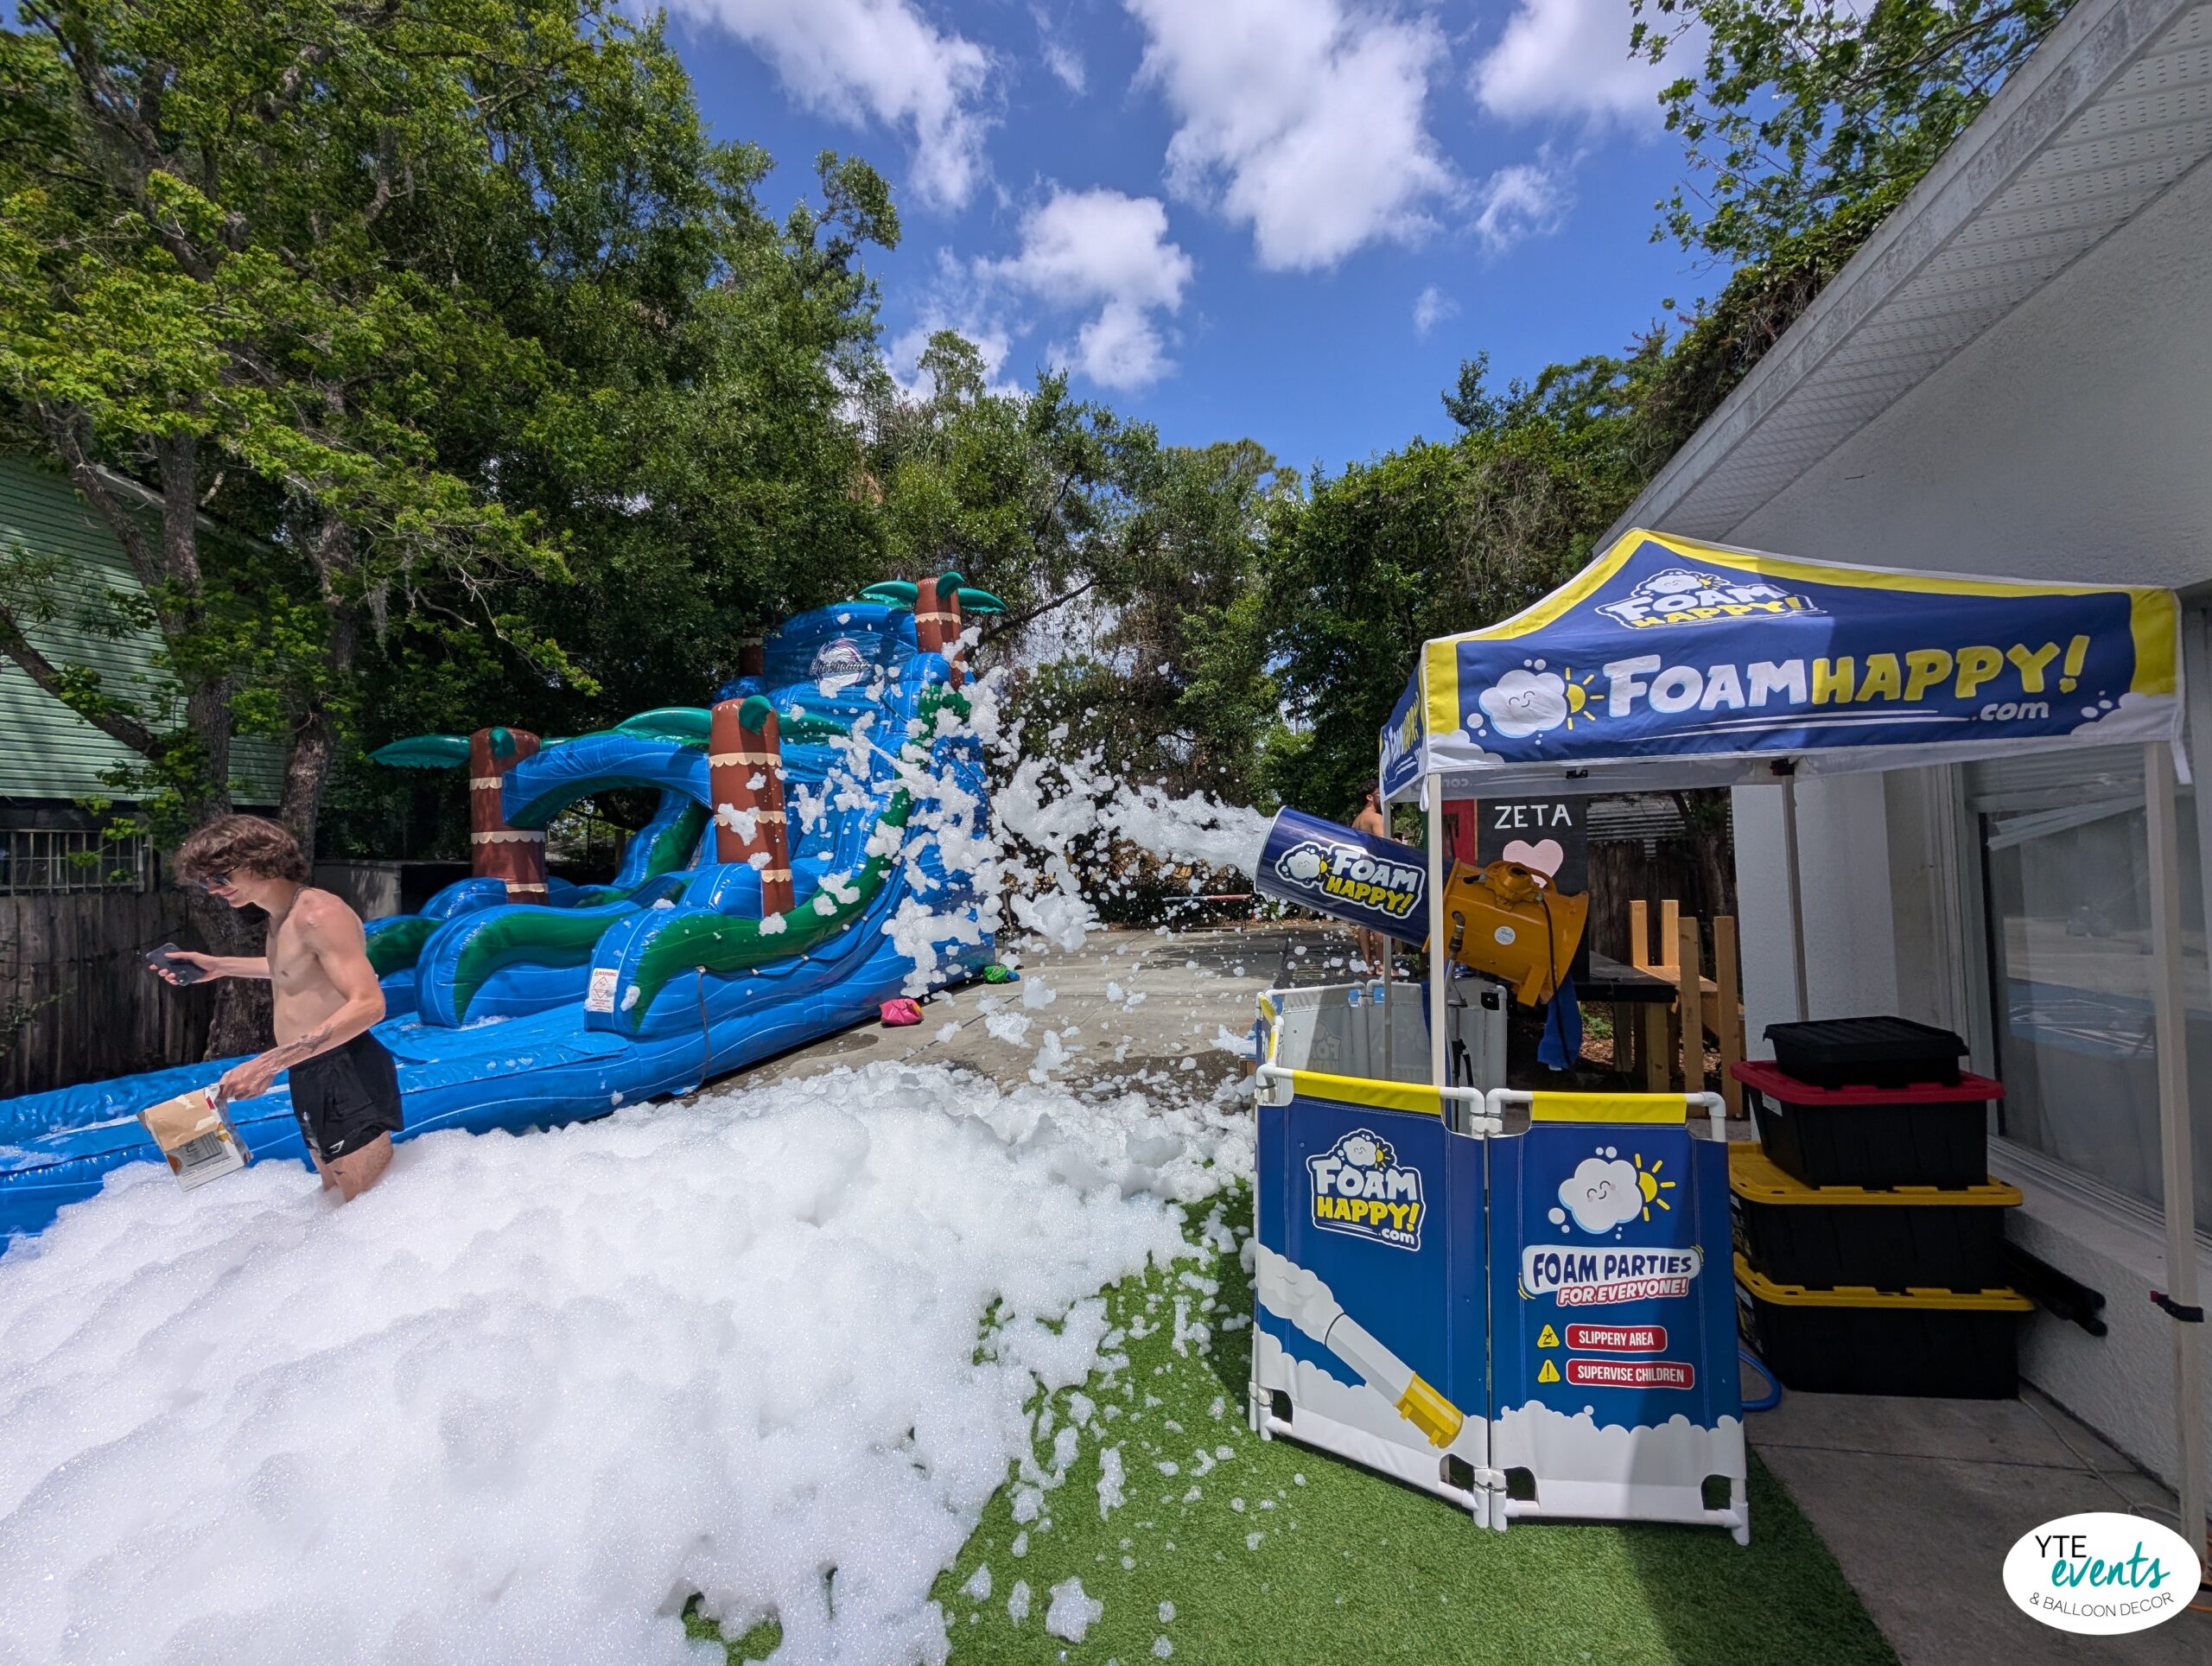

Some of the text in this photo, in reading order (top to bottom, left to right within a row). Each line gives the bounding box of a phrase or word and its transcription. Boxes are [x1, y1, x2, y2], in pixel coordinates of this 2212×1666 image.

[1605, 585, 1787, 620] FOAM
[1630, 595, 1803, 627] HAPPY!
[1972, 700, 2049, 722] .com
[1494, 804, 1573, 830] ZETA
[1332, 849, 1418, 892] FOAM
[1325, 875, 1414, 913] HAPPY!
[1312, 1155, 1417, 1200] FOAM
[1317, 1196, 1420, 1231] HAPPY!
[1377, 1228, 1414, 1244] .com
[1533, 1252, 1692, 1288] FOAM PARTIES
[1558, 1278, 1688, 1304] FOR EVERYONE!
[1579, 1330, 1655, 1346] SLIPPERY AREA
[1578, 1364, 1684, 1383] SUPERVISE CHILDREN
